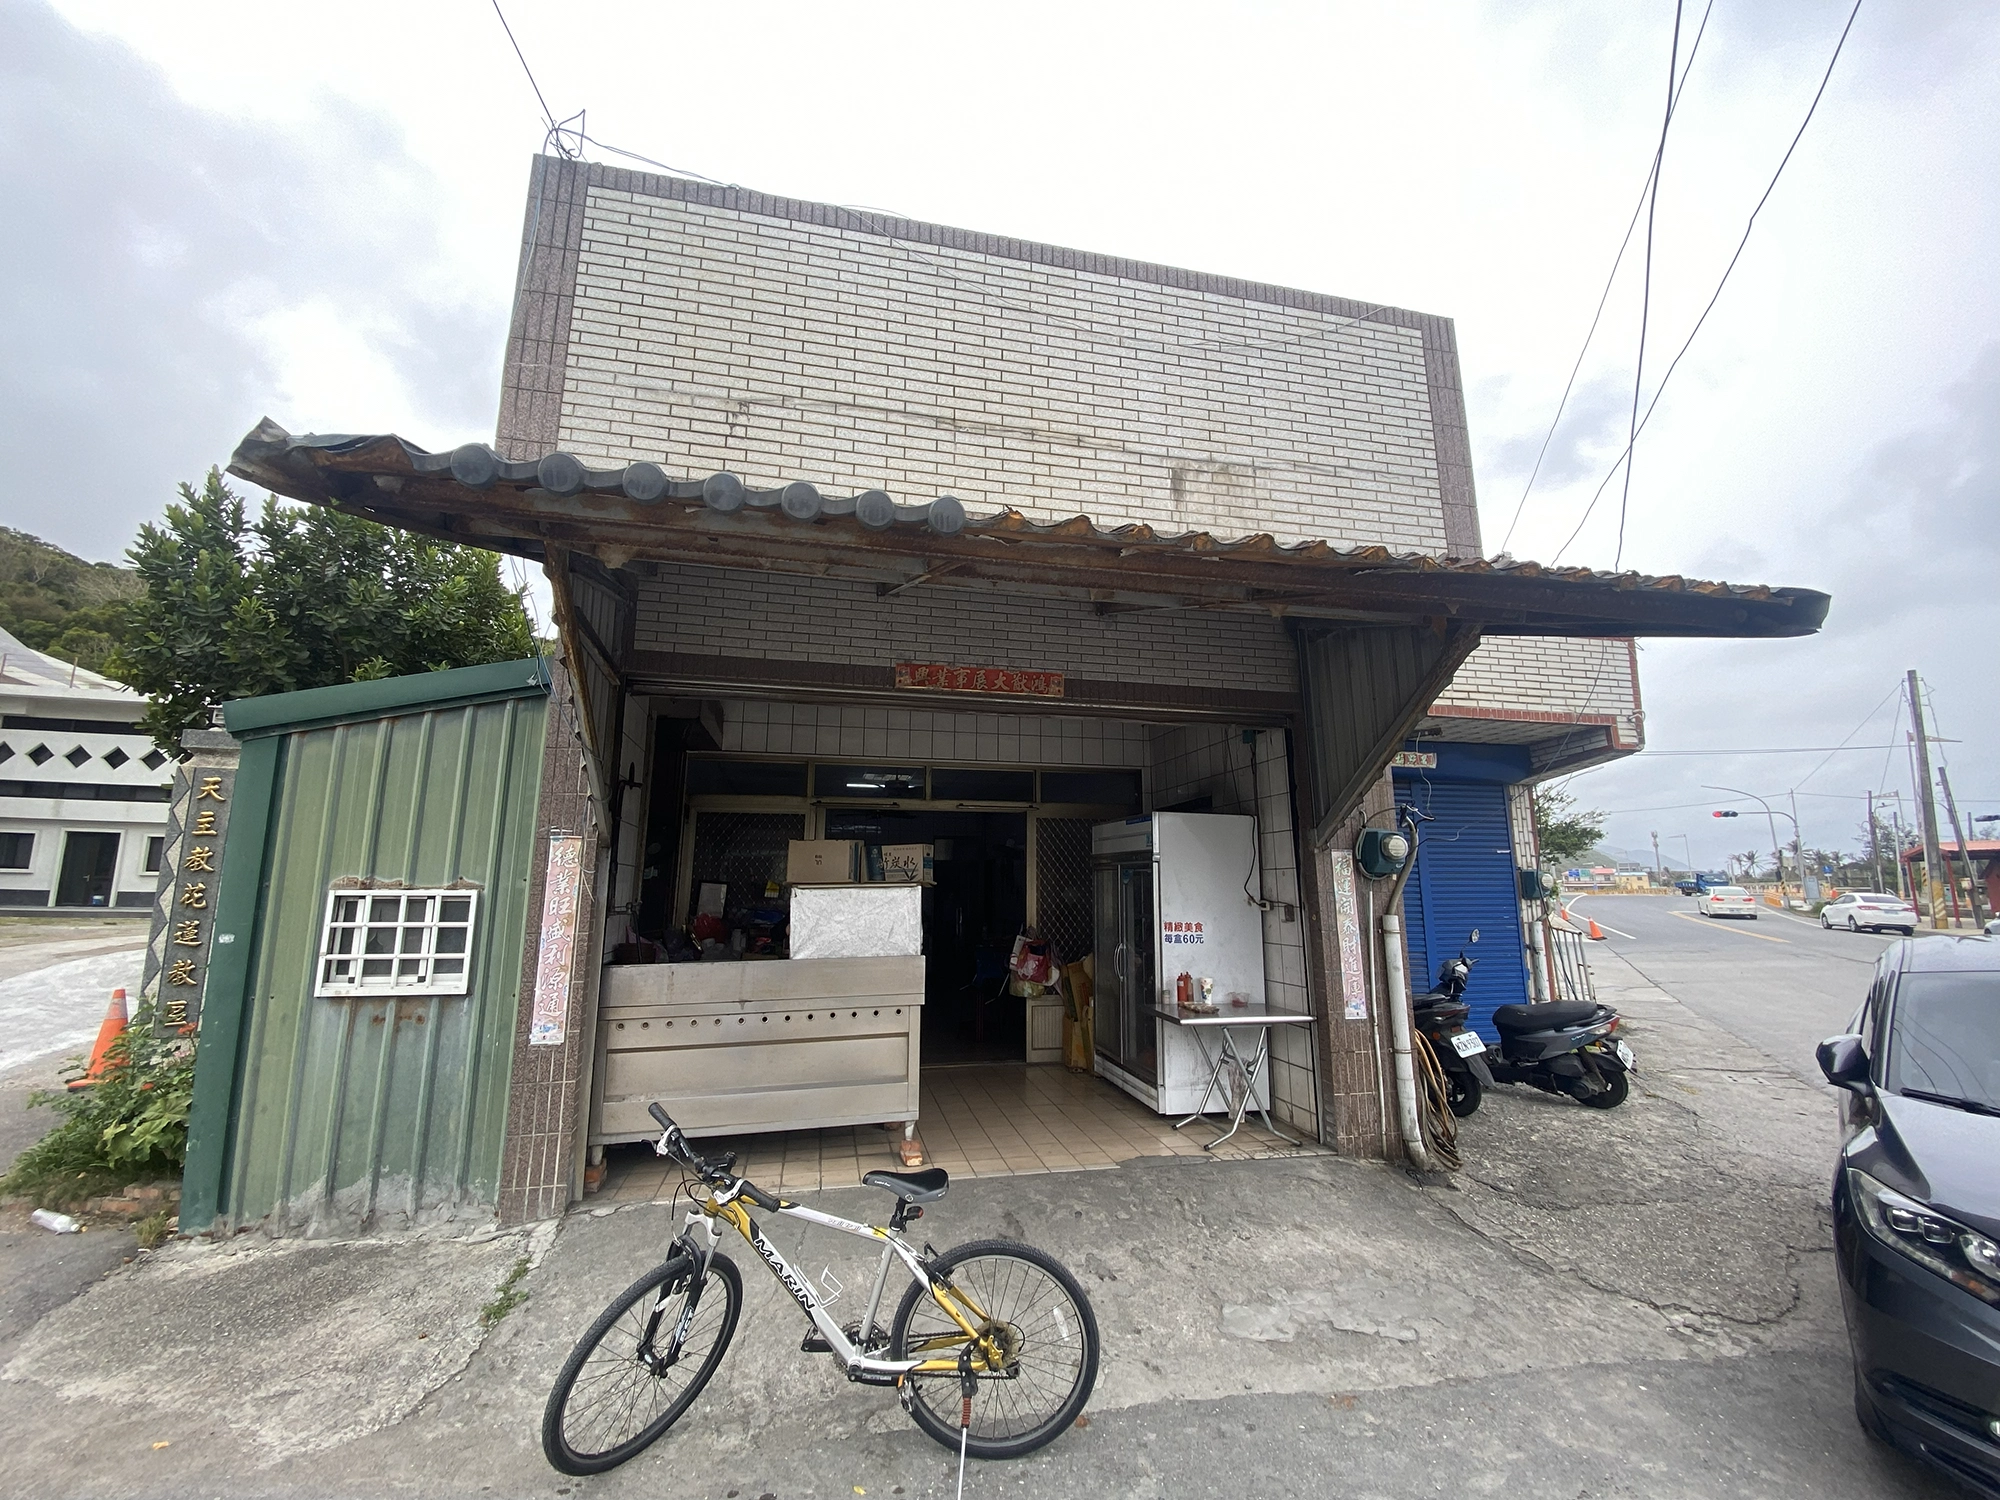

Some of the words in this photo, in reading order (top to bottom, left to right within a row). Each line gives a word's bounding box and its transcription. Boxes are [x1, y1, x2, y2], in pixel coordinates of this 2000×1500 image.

[164, 776, 226, 1027] 天主教花蓮教區
[538, 844, 579, 1016] 德業旺盛利源通
[1163, 921, 1204, 933] 精緻美食
[1164, 933, 1205, 944] 每盒60元
[753, 1237, 816, 1311] MARIN
